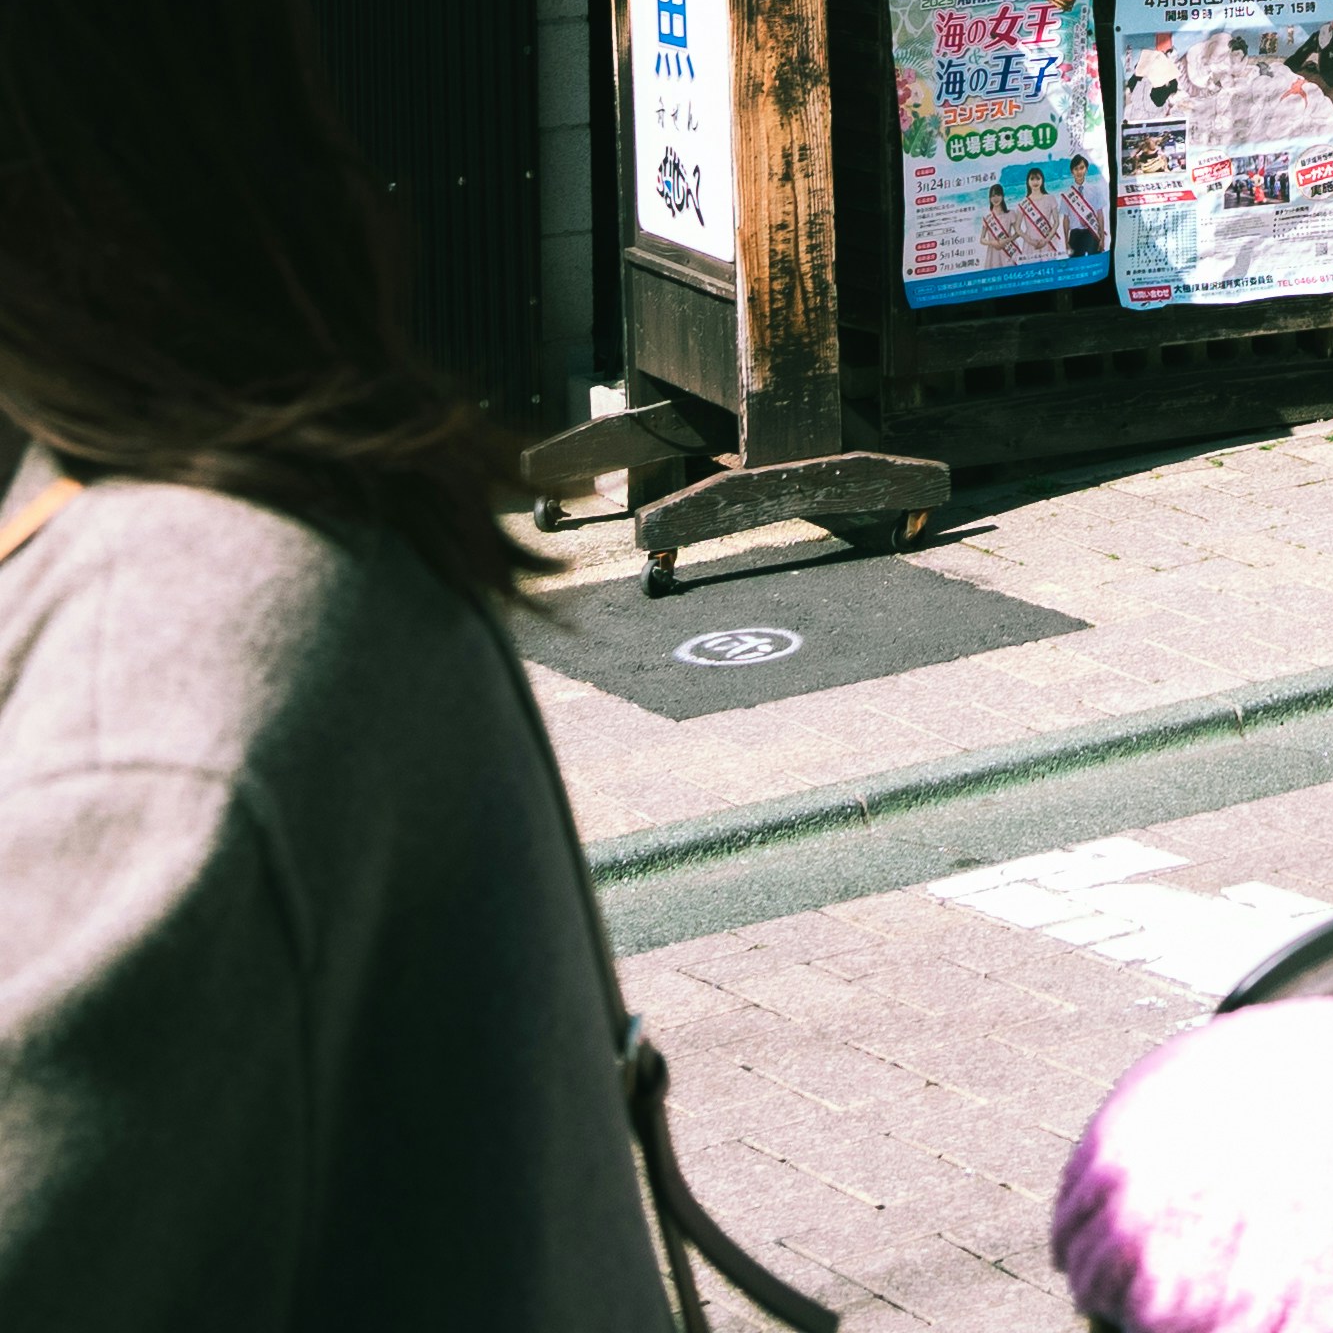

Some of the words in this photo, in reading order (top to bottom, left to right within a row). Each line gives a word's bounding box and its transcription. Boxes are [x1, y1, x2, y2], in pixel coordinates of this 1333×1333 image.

[935, 4, 1057, 54] 海の女王
[936, 53, 1059, 101] 海の王子
[943, 99, 1022, 125] コンテスト
